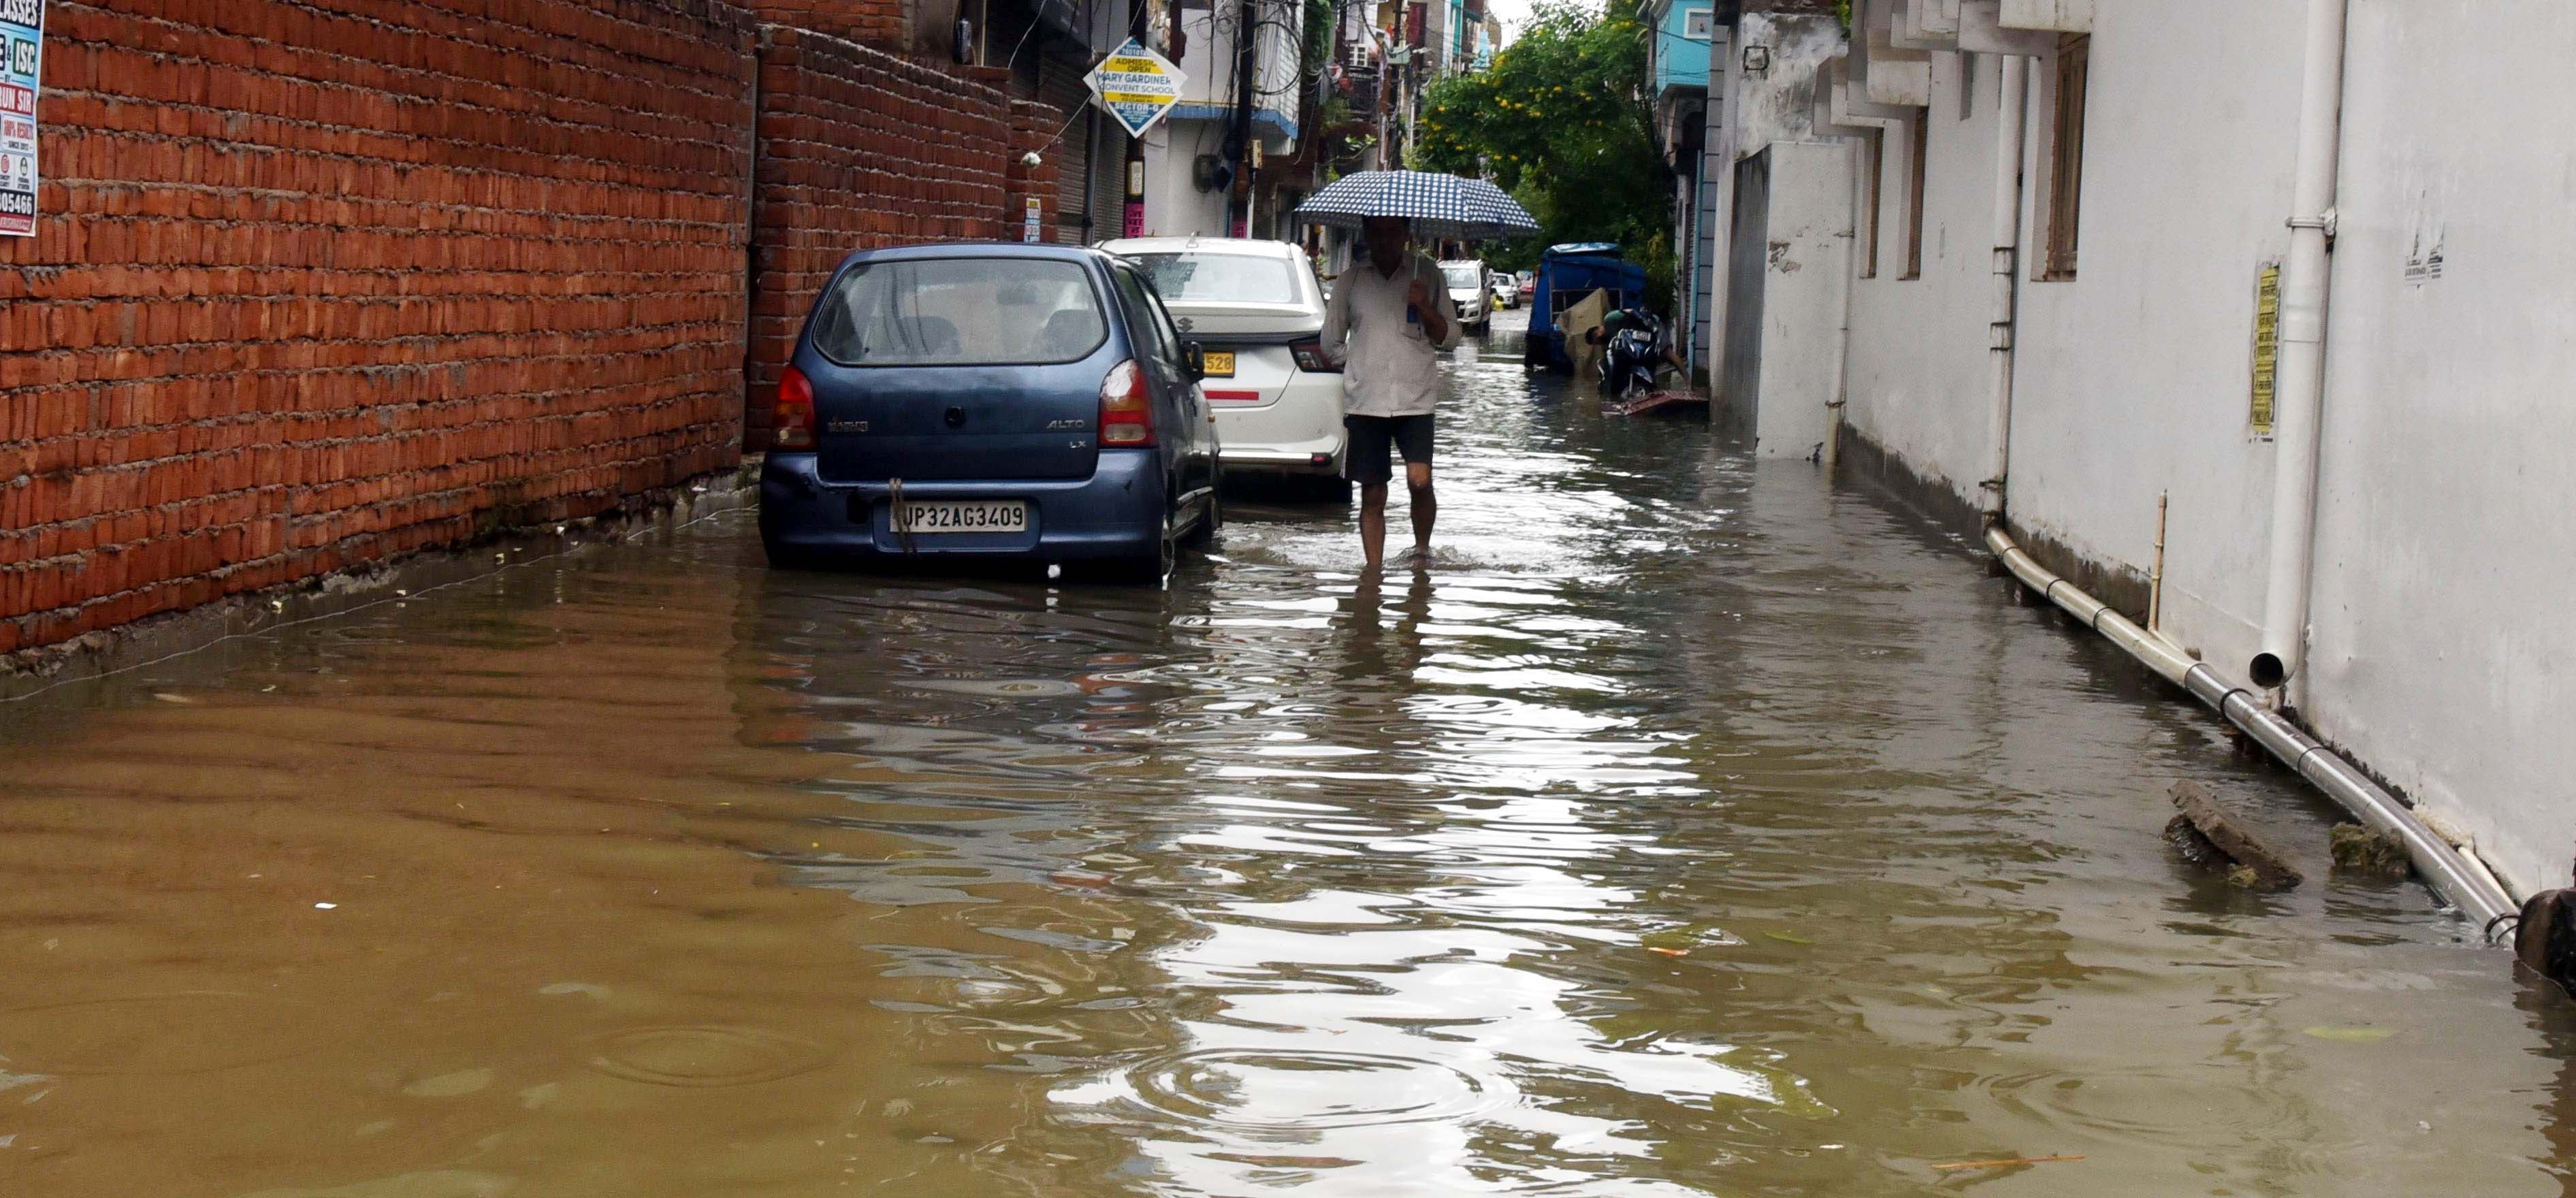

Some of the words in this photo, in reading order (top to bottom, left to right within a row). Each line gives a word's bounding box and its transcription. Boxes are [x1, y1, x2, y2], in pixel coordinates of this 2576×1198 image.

[7, 45, 11, 61] &
[16, 42, 35, 74] ISC
[1097, 72, 1123, 82] MARY
[1099, 83, 1140, 93] CONVENT
[1141, 85, 1175, 94] SCHOOL
[17, 90, 31, 113] SIR
[0, 192, 32, 214] 05466
[1046, 419, 1085, 430] ALTO
[1069, 440, 1087, 449] LX
[903, 506, 1023, 527] UP32AG3409
